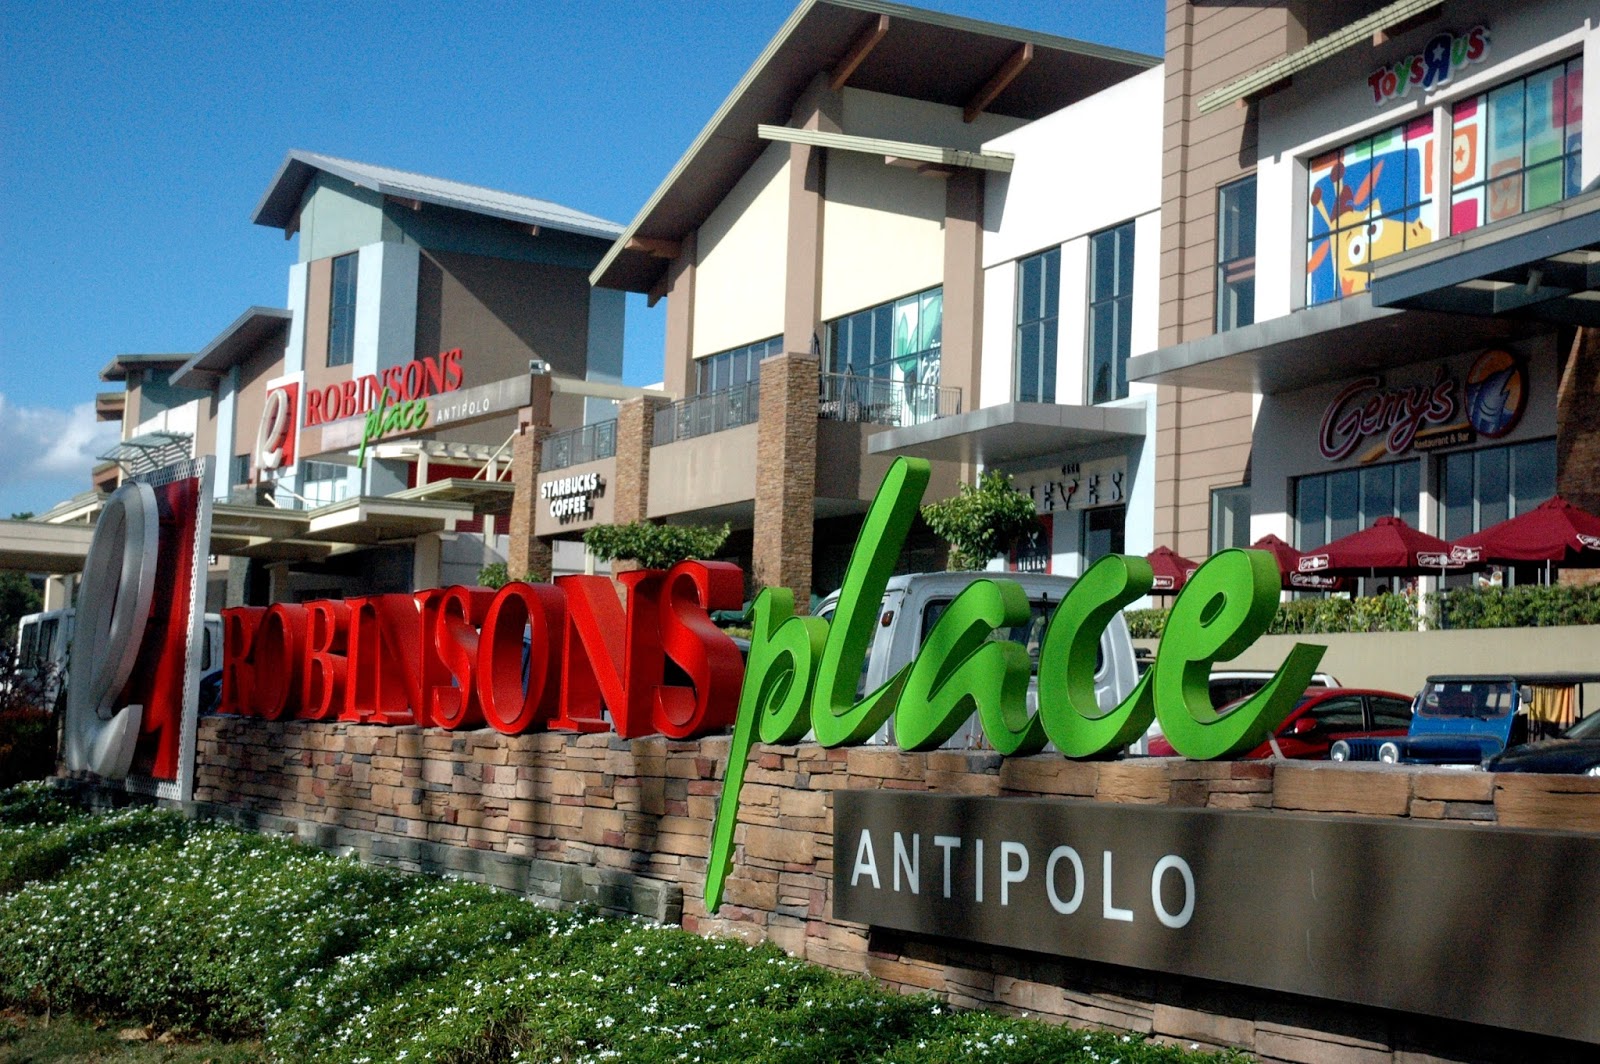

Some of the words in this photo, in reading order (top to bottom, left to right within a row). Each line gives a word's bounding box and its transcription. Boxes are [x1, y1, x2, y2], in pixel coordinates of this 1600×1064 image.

[303, 347, 464, 428] ROBINSONS
[357, 386, 429, 469] place
[436, 398, 491, 423] ANTIPOLO
[1319, 367, 1454, 462] Gerry's
[541, 472, 598, 499] STARBUCKS
[549, 495, 587, 518] COFFEE
[220, 559, 744, 740] ROBINSONS
[705, 456, 1328, 913] place
[850, 828, 1196, 930] ANTIPOLO
